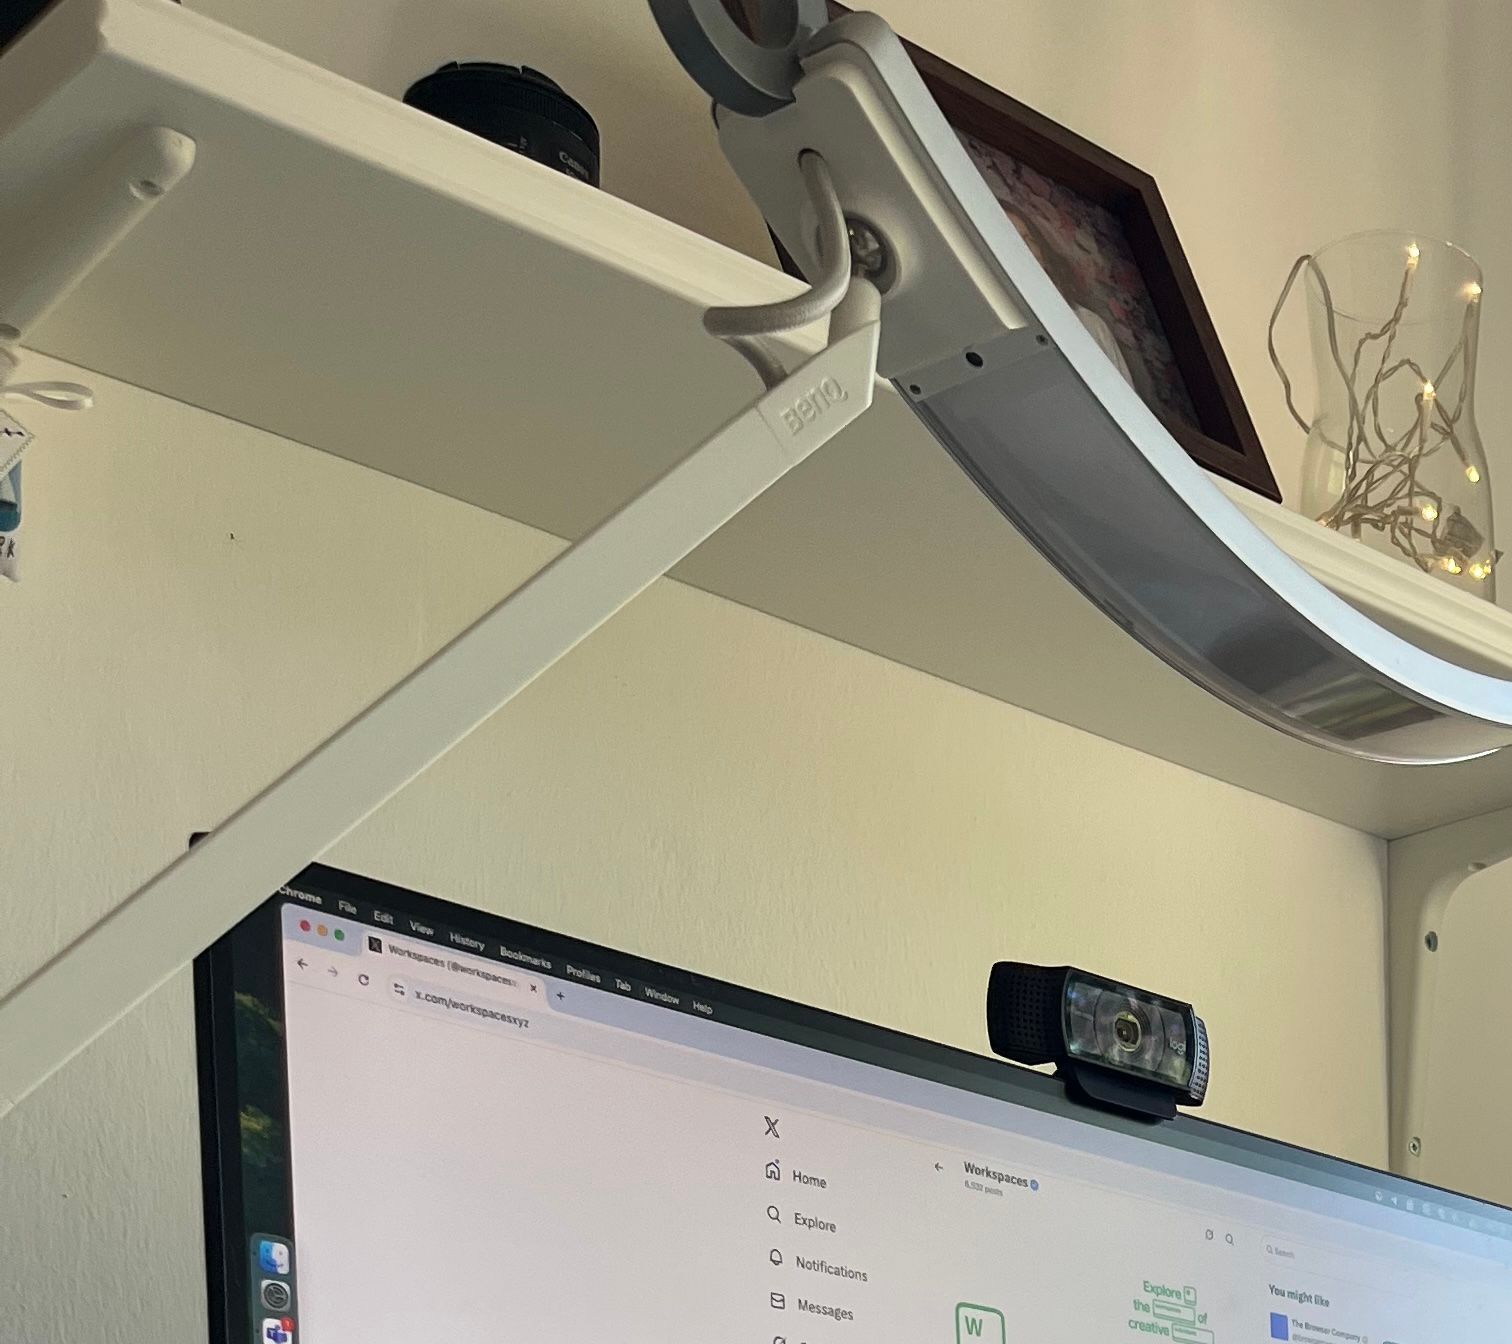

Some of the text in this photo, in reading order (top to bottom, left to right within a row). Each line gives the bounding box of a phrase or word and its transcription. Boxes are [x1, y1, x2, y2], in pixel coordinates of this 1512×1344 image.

[338, 900, 357, 915] File
[373, 910, 394, 925] Edit
[409, 920, 434, 936] View
[450, 932, 485, 951] History
[500, 945, 551, 969] Bookmarks
[566, 964, 601, 982] Profiles
[615, 978, 631, 992] Tab
[644, 987, 680, 1005] Window
[692, 1000, 713, 1015] Help
[389, 943, 445, 968] Workspaces
[415, 990, 529, 1029] x.com/workspacesxyz
[793, 1170, 827, 1189] Home
[964, 1161, 1028, 1187] Workspaces
[794, 1212, 837, 1232] Explore
[796, 1256, 868, 1282] Notifications
[1143, 1280, 1182, 1300] Explore
[1268, 1283, 1330, 1307] You might like
[798, 1298, 854, 1321] Messages
[1133, 1299, 1150, 1313] the
[1198, 1312, 1207, 1324] of
[965, 1315, 983, 1337] W
[1128, 1319, 1170, 1336] creative
[1331, 1329, 1361, 1344] Company
